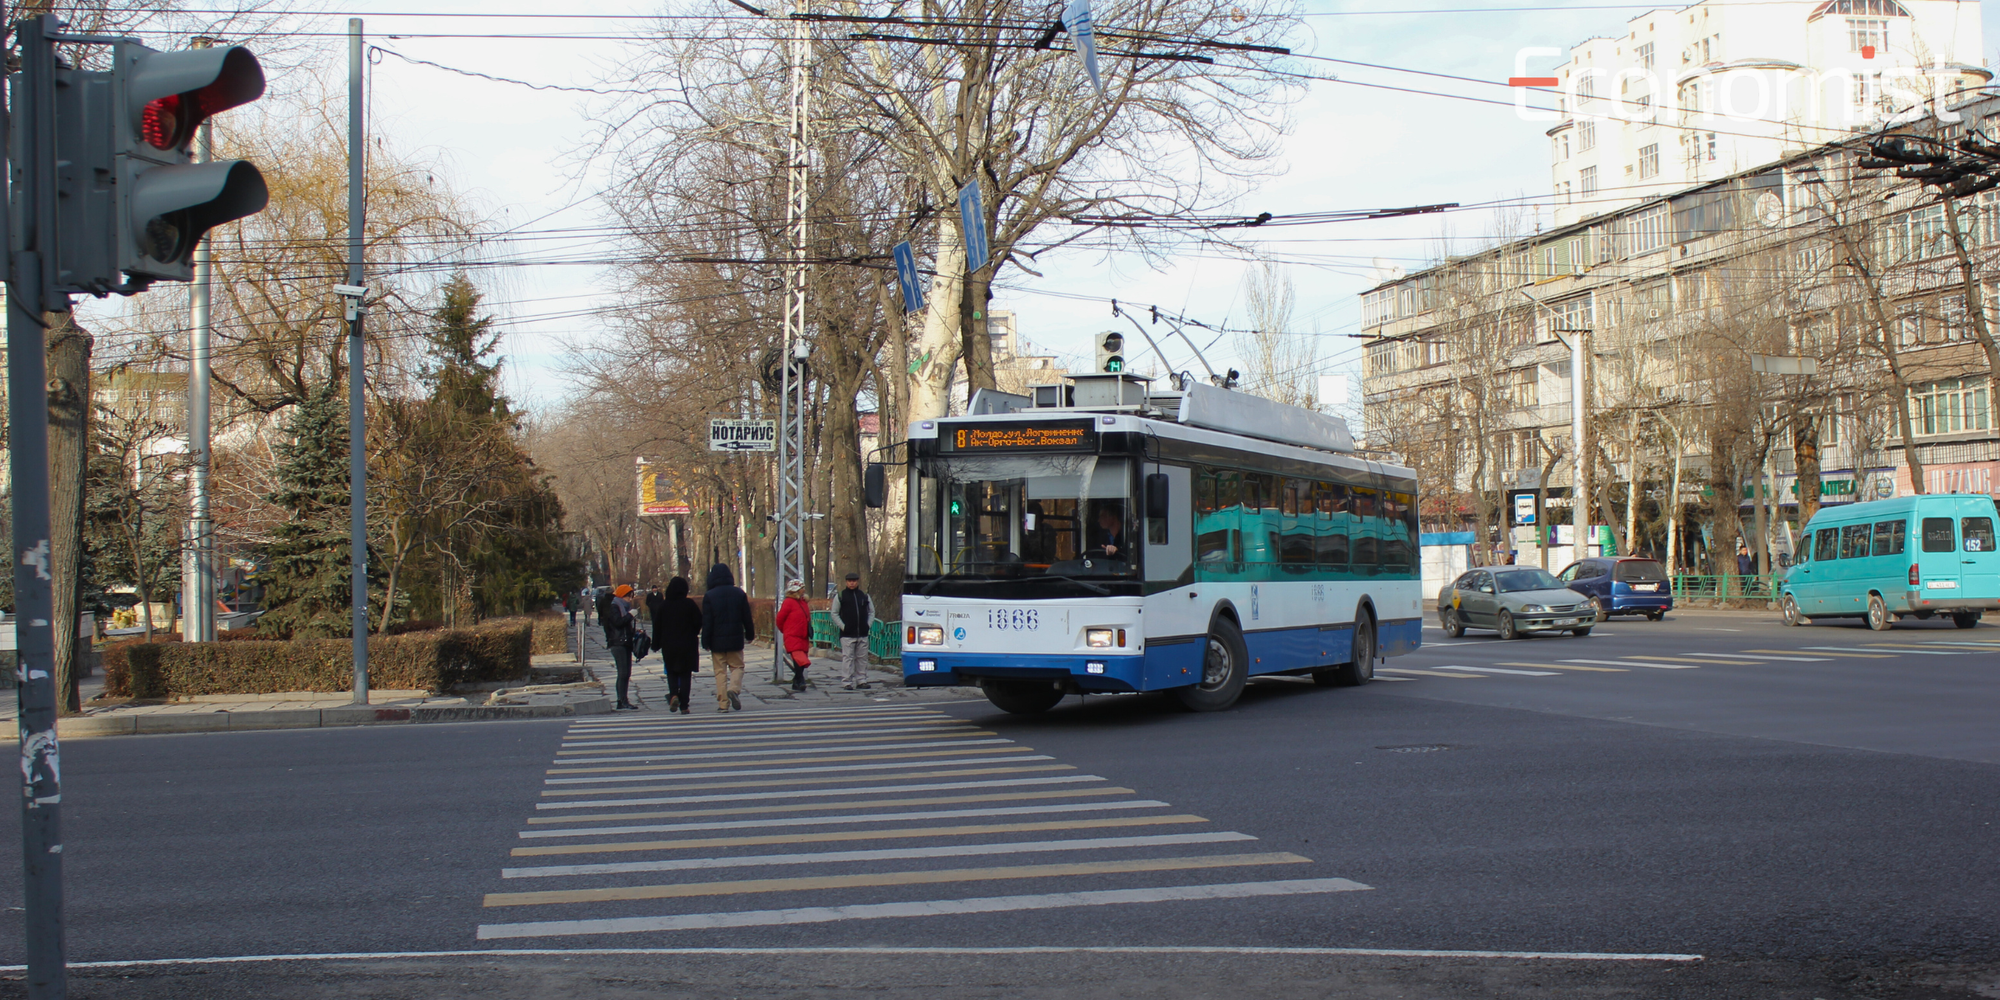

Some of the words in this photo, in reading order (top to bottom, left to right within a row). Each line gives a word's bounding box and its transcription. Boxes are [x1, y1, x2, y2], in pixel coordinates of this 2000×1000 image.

[712, 425, 774, 441] НОТАРИУС
[957, 429, 967, 448] 8
[1965, 539, 1981, 552] 152
[988, 608, 1040, 630] 1866
